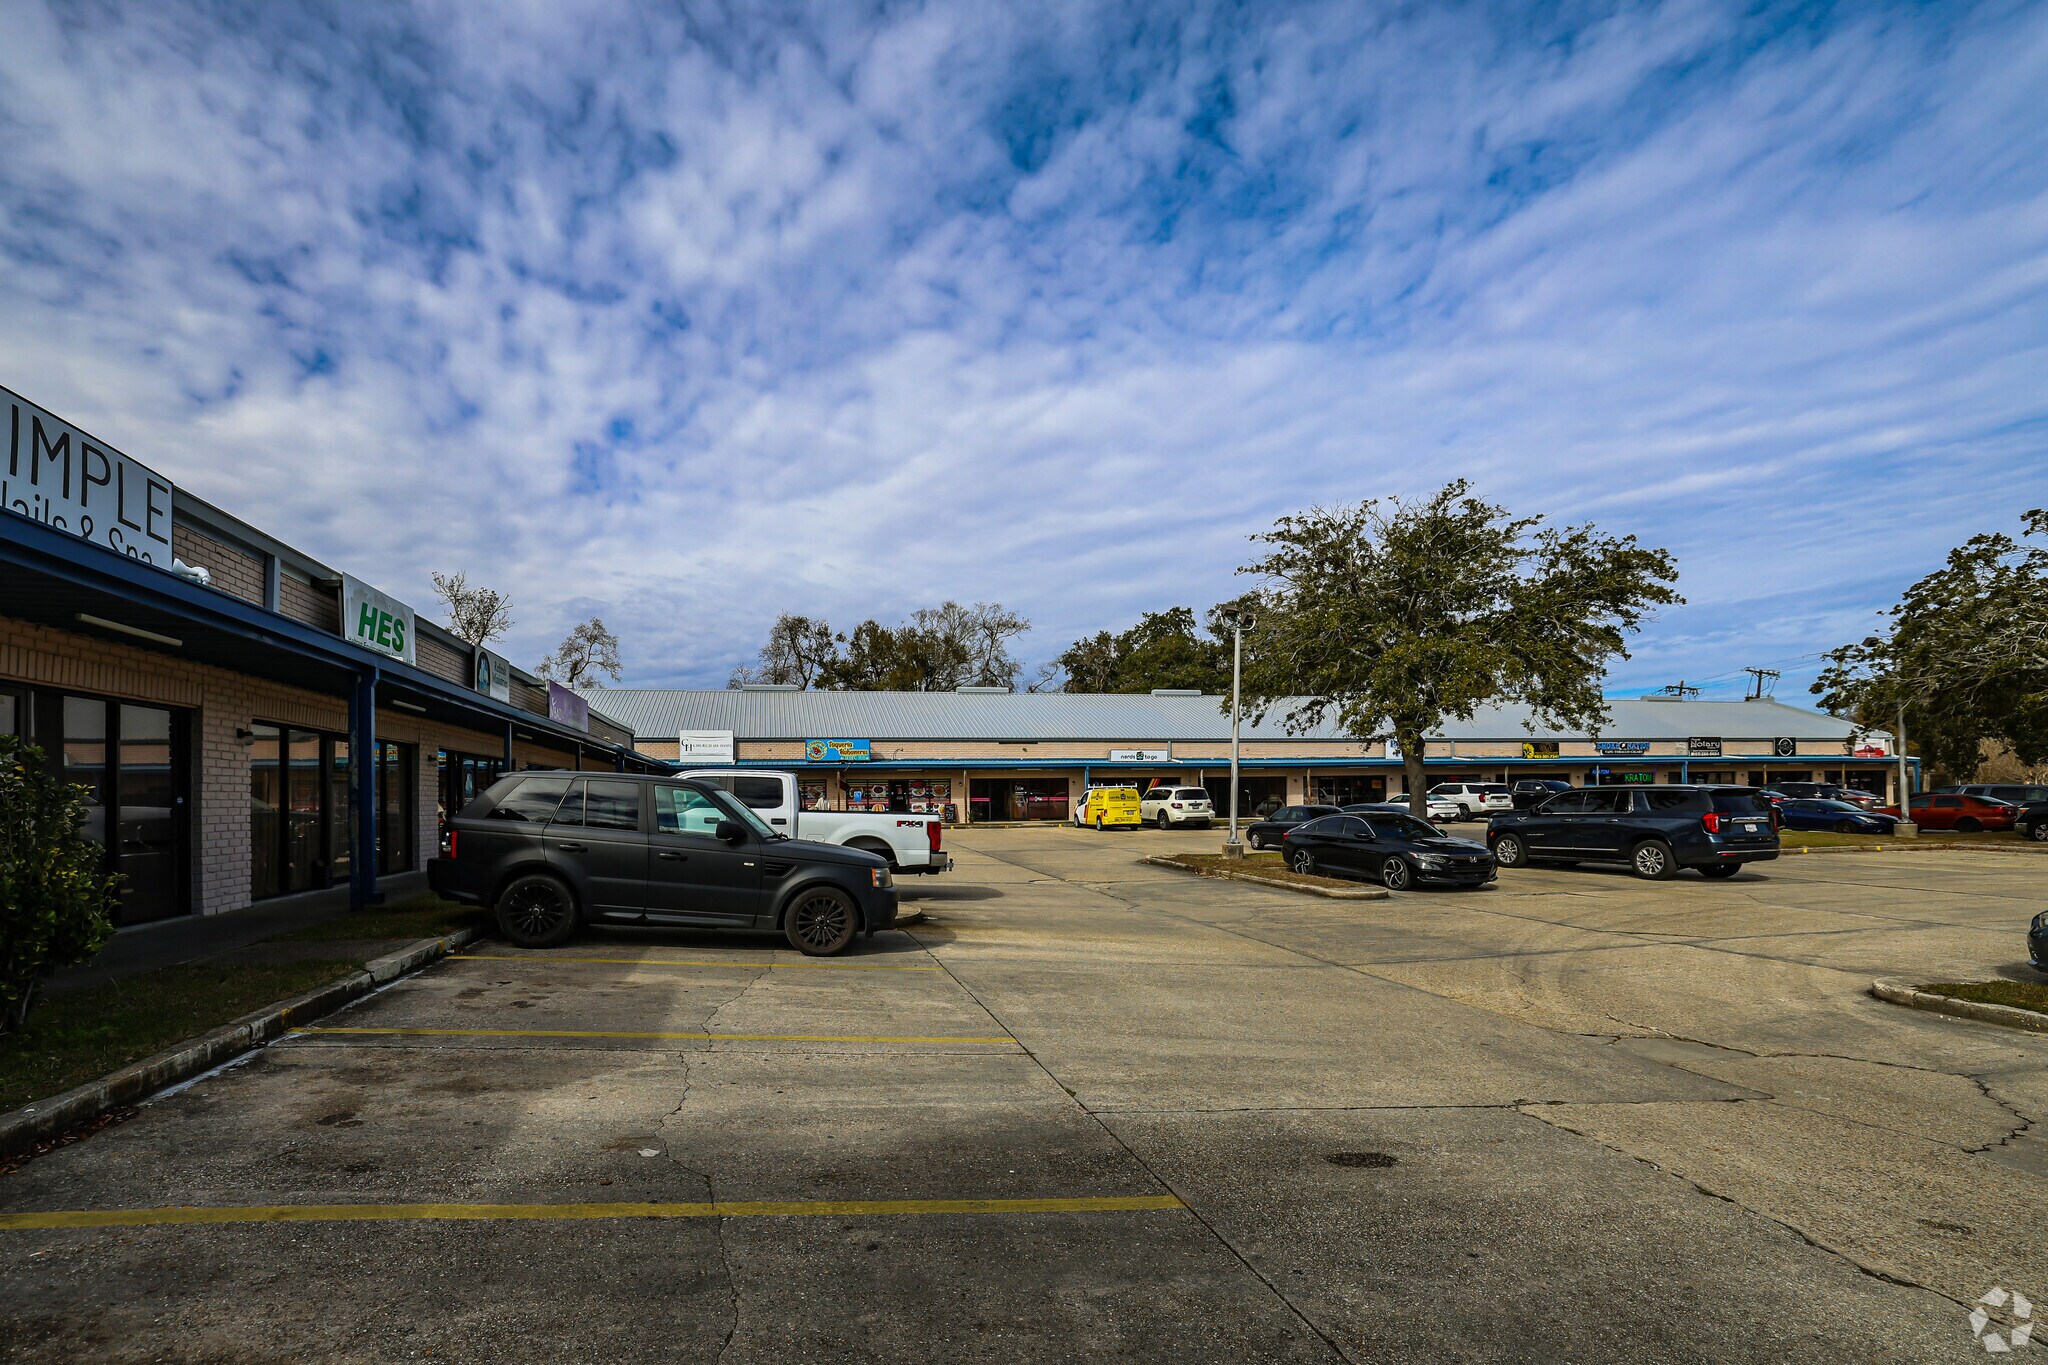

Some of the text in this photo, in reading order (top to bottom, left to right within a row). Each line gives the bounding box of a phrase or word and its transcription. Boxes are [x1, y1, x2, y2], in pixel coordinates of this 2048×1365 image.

[358, 602, 405, 652] HES
[1691, 740, 1720, 749] Notary
[896, 820, 924, 828] FX4
